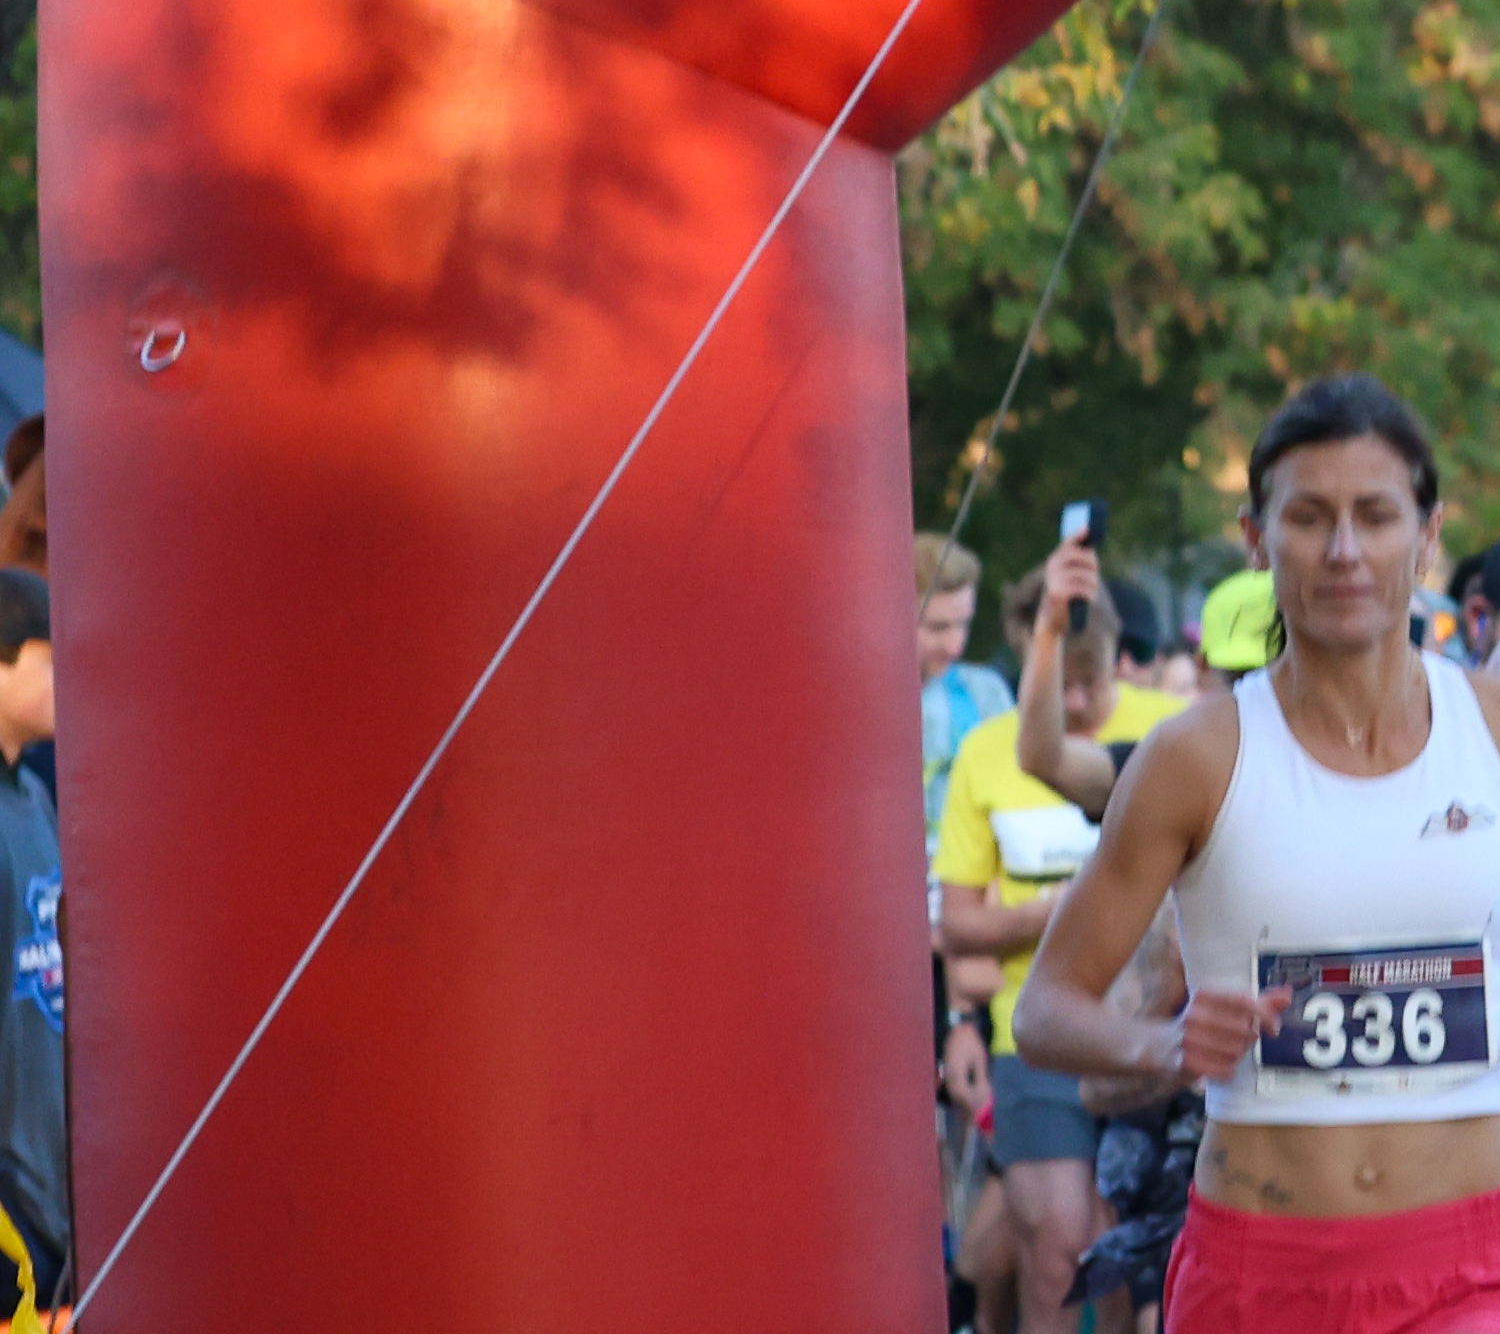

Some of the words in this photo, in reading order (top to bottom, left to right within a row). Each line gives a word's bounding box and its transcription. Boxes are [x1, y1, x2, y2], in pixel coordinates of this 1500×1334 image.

[1350, 961, 1381, 987] HALF
[1383, 956, 1452, 985] MARATHON
[1302, 987, 1446, 1069] 336
